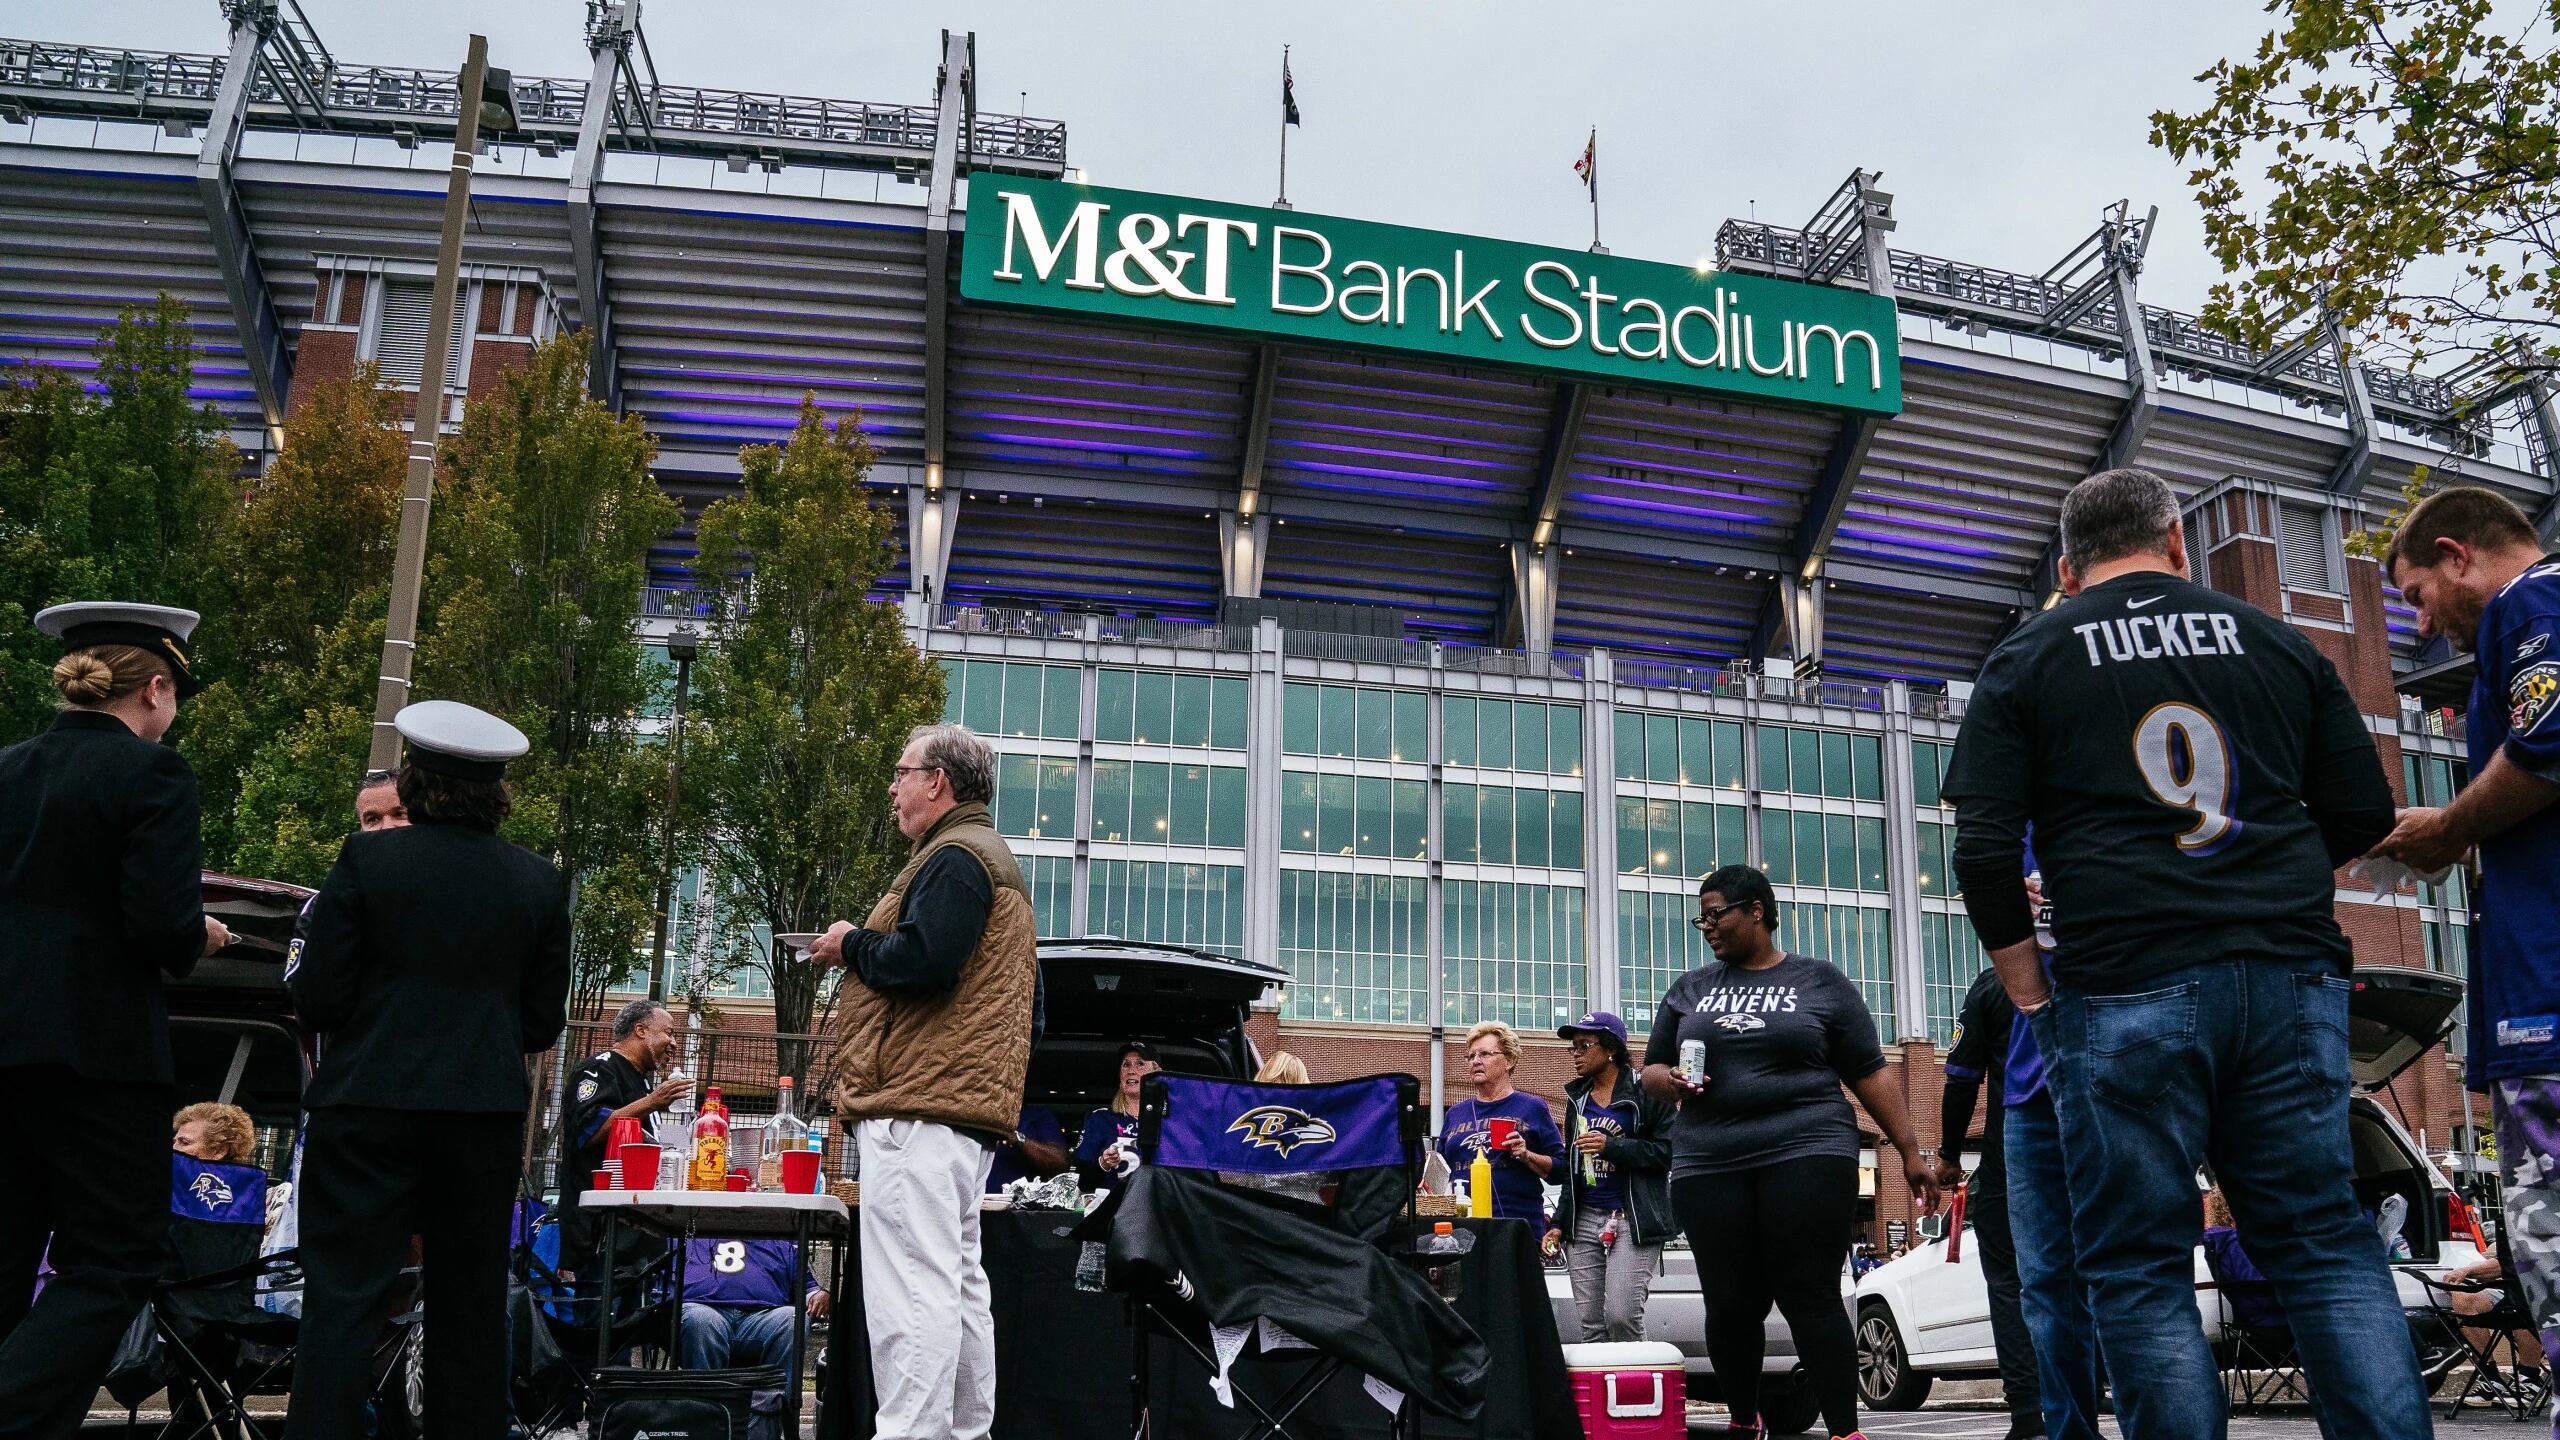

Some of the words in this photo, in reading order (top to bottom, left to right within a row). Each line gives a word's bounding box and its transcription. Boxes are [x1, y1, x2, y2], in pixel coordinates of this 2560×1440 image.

[992, 190, 1259, 307] M&T
[1270, 224, 1503, 342] Bank
[1520, 259, 1882, 392] Stadium
[2073, 612, 2245, 667] TUCKER
[2132, 700, 2242, 857] 9
[1695, 994, 1798, 1013] RAVENS
[1709, 986, 1796, 996] BALTIMORE
[714, 1240, 746, 1274] 8
